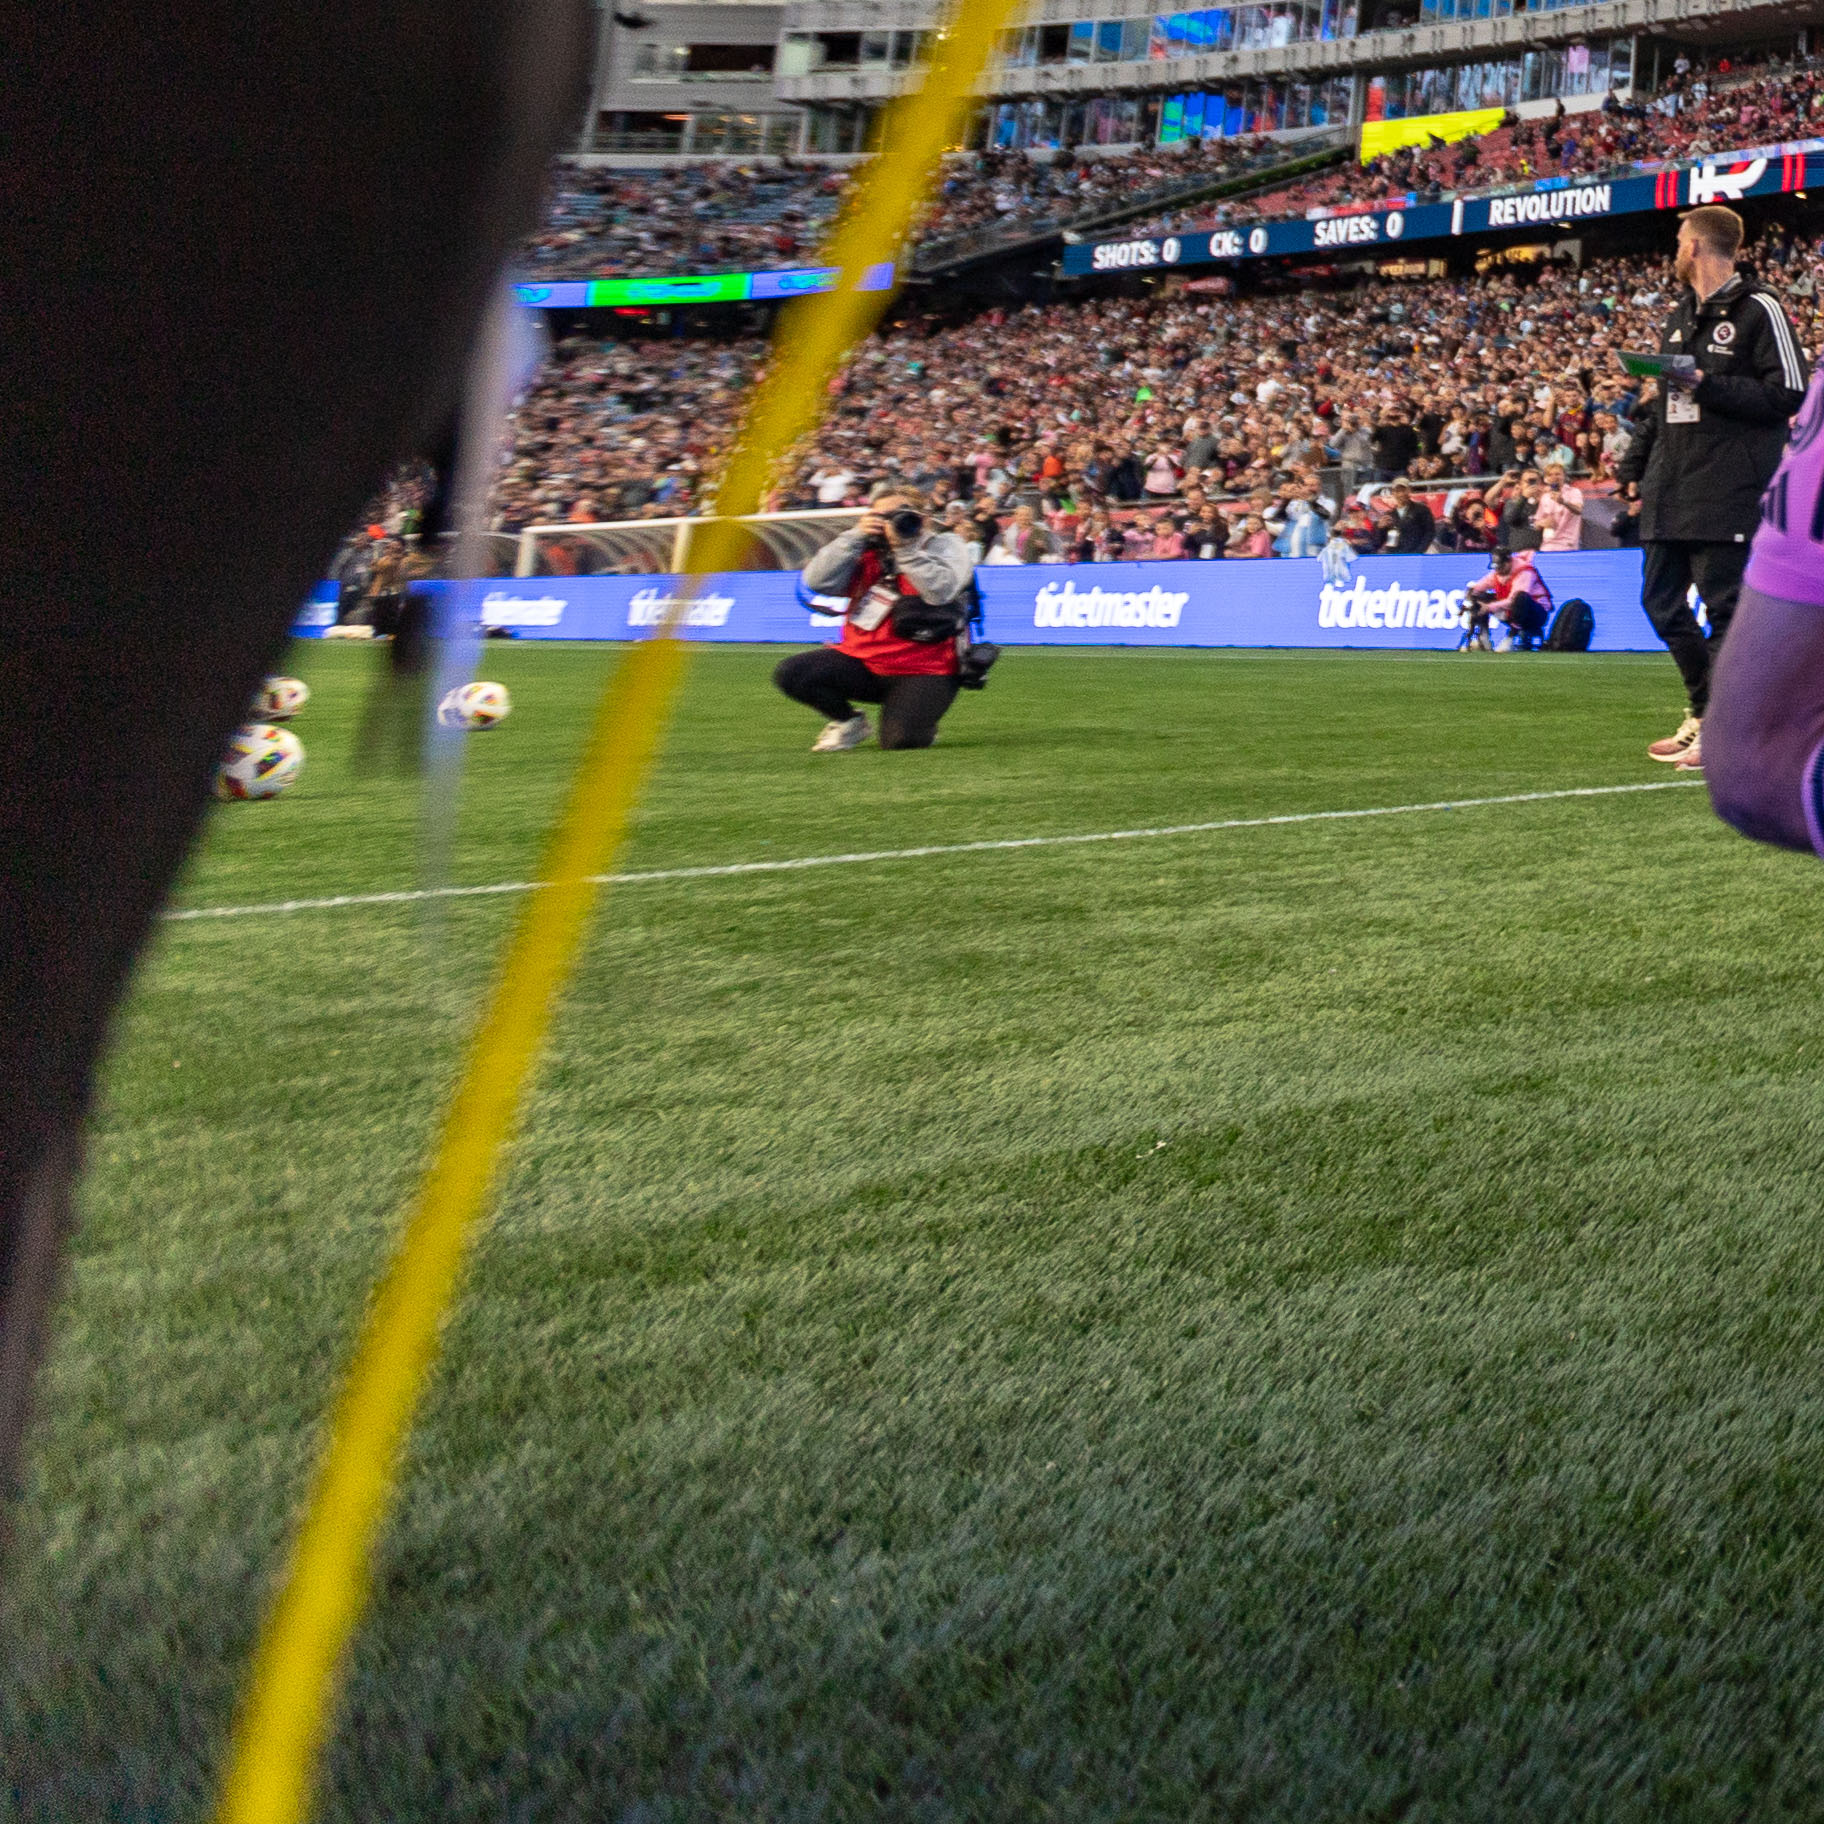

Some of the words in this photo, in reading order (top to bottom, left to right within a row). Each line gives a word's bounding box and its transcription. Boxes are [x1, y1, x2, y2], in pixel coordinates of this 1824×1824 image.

[1488, 184, 1612, 227] REVOLUTION
[1092, 239, 1160, 271] SHOTS:
[1162, 237, 1180, 264] 0
[1209, 230, 1245, 258] CK:
[1249, 226, 1269, 255] 0
[1313, 215, 1380, 246] SAVES:
[1385, 211, 1405, 240] 0
[1033, 580, 1190, 629] ticketmaster
